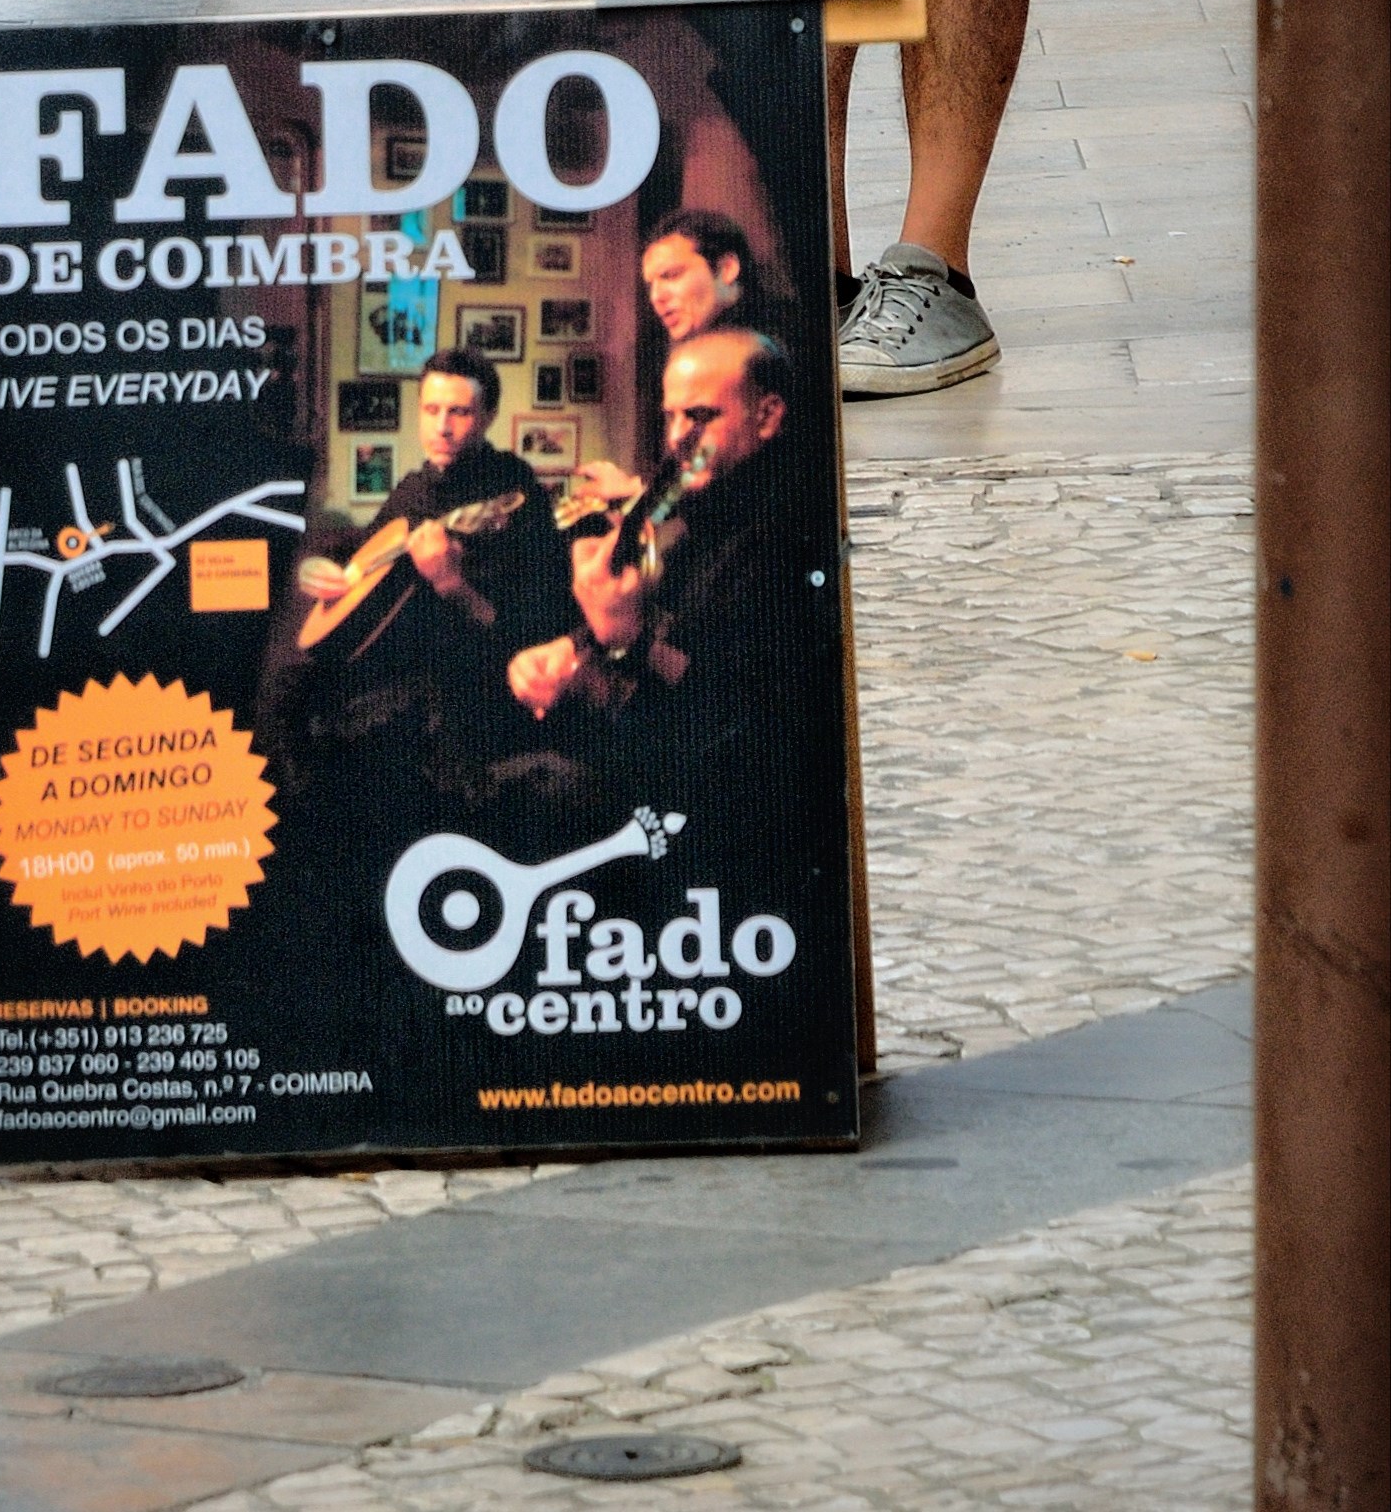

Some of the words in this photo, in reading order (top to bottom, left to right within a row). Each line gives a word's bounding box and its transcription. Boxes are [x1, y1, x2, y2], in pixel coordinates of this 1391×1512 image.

[98, 229, 476, 291] COIMBRA
[115, 317, 170, 353] OS
[180, 314, 267, 351] DIAS
[64, 368, 272, 407] EVERYDAY
[30, 744, 67, 769] DE
[78, 728, 218, 764] SEGUNDA
[41, 780, 58, 801] A
[69, 762, 212, 799] DOMINGO
[15, 814, 112, 842] MONDAY
[121, 809, 150, 831] TO
[157, 798, 249, 826] SUNDAY
[19, 849, 94, 879] 18H00
[204, 837, 251, 858] min.)
[61, 885, 103, 903] Inclui
[109, 880, 153, 899] Vinho
[158, 877, 177, 893] do
[181, 872, 224, 892] Porto
[68, 906, 101, 923] Port
[109, 901, 147, 918] Wine
[152, 893, 218, 914] included
[536, 887, 797, 986] fado
[113, 995, 209, 1017] BOOKING
[445, 994, 484, 1016] ao
[486, 976, 743, 1036] centro
[104, 1025, 142, 1048] 913
[147, 1024, 186, 1046] 236
[191, 1022, 228, 1044] 725
[38, 1054, 76, 1076] 837
[80, 1053, 119, 1075] 060
[137, 1051, 175, 1073] 239
[179, 1050, 218, 1071] 405
[224, 1048, 261, 1070] 105
[41, 1080, 117, 1102] Quebra
[122, 1077, 199, 1099] Costas,
[239, 1075, 253, 1097] 7
[269, 1071, 374, 1095] COIMBRA
[477, 1079, 801, 1109] www.fadoaocentro.com
